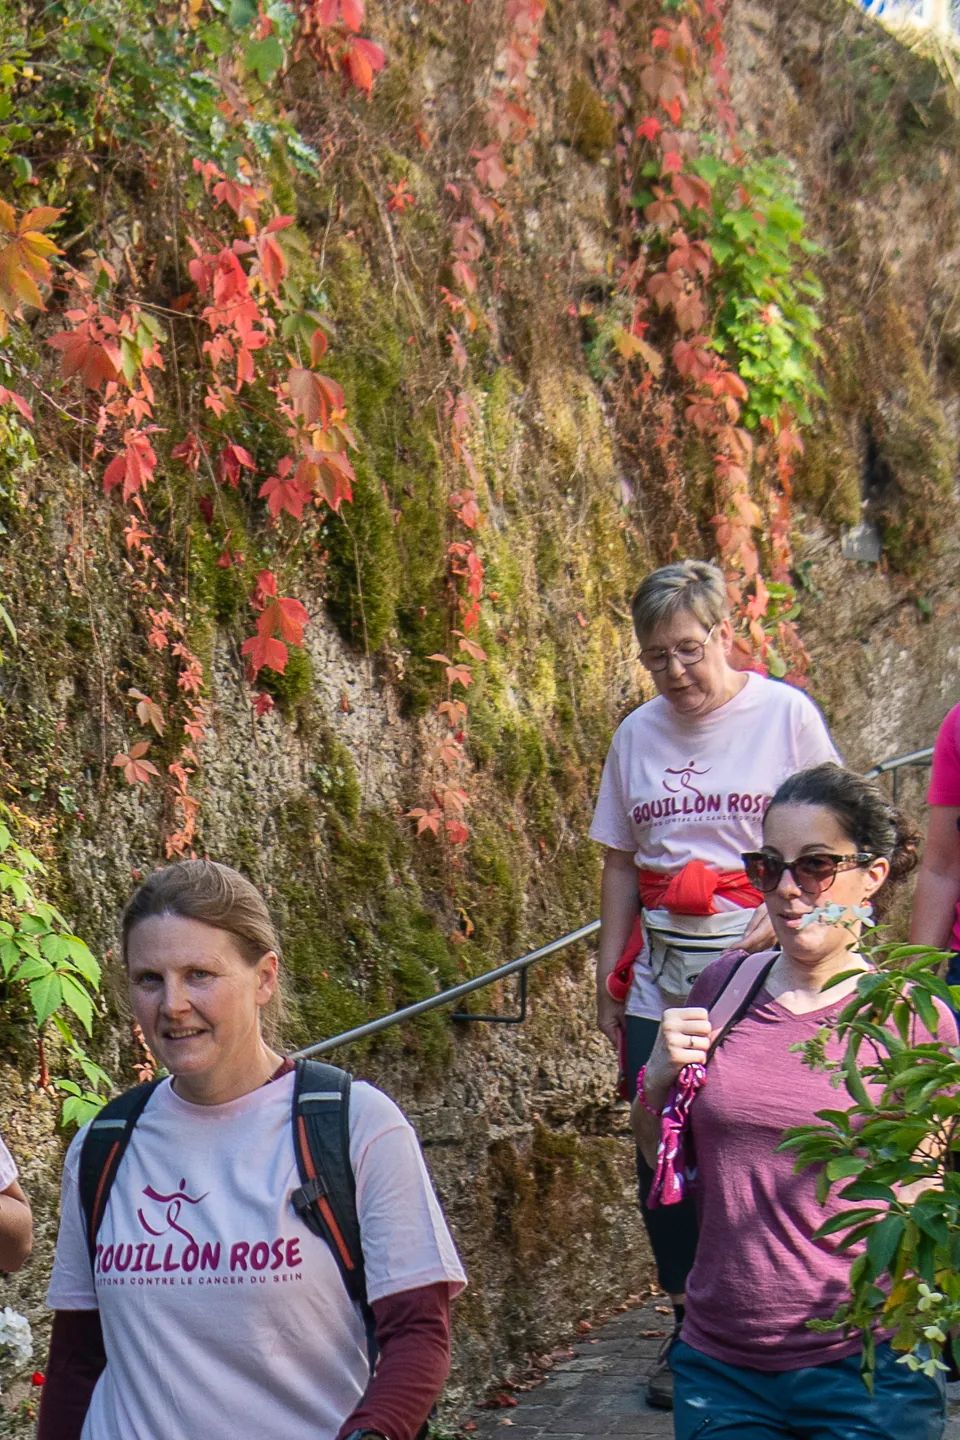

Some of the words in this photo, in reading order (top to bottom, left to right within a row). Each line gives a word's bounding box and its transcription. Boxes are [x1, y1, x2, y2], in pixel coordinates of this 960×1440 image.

[632, 794, 721, 825] BOUILLON
[230, 1237, 303, 1271] ROSE
[130, 1277, 175, 1286] CONTRE
[181, 1277, 193, 1285] LE
[198, 1276, 244, 1285] CANCER
[250, 1275, 266, 1284] DU
[273, 1272, 302, 1283] SEIN
